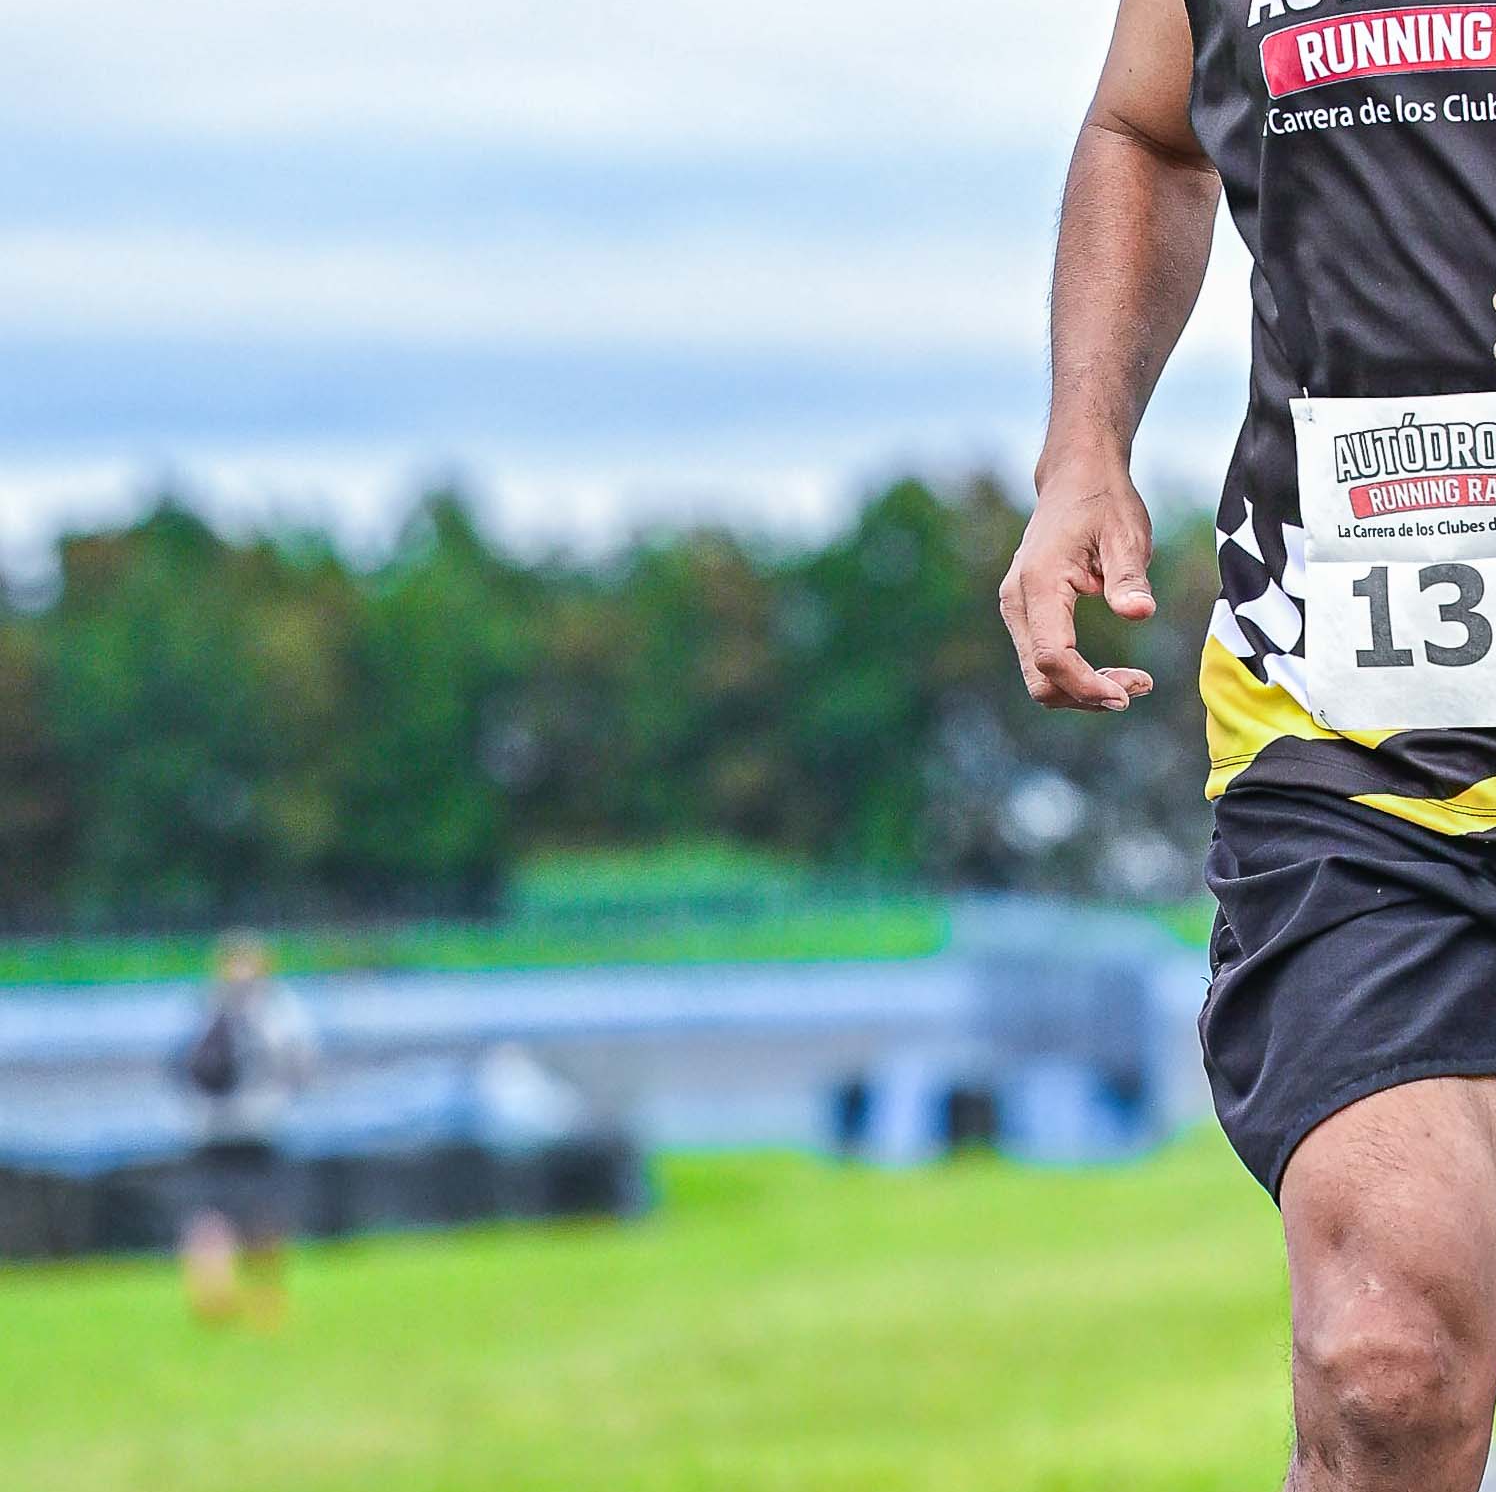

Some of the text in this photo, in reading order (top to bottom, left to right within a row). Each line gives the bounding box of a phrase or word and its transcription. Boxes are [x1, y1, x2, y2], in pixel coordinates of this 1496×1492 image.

[1296, 11, 1493, 82] RUNNING
[1358, 95, 1392, 125] de
[1394, 94, 1437, 123] los
[1368, 478, 1460, 514] RUNNING
[1337, 524, 1351, 538] La
[1353, 524, 1396, 538] Carrera
[1398, 522, 1414, 537] de
[1416, 522, 1435, 536] los
[1437, 519, 1486, 535] Clubes
